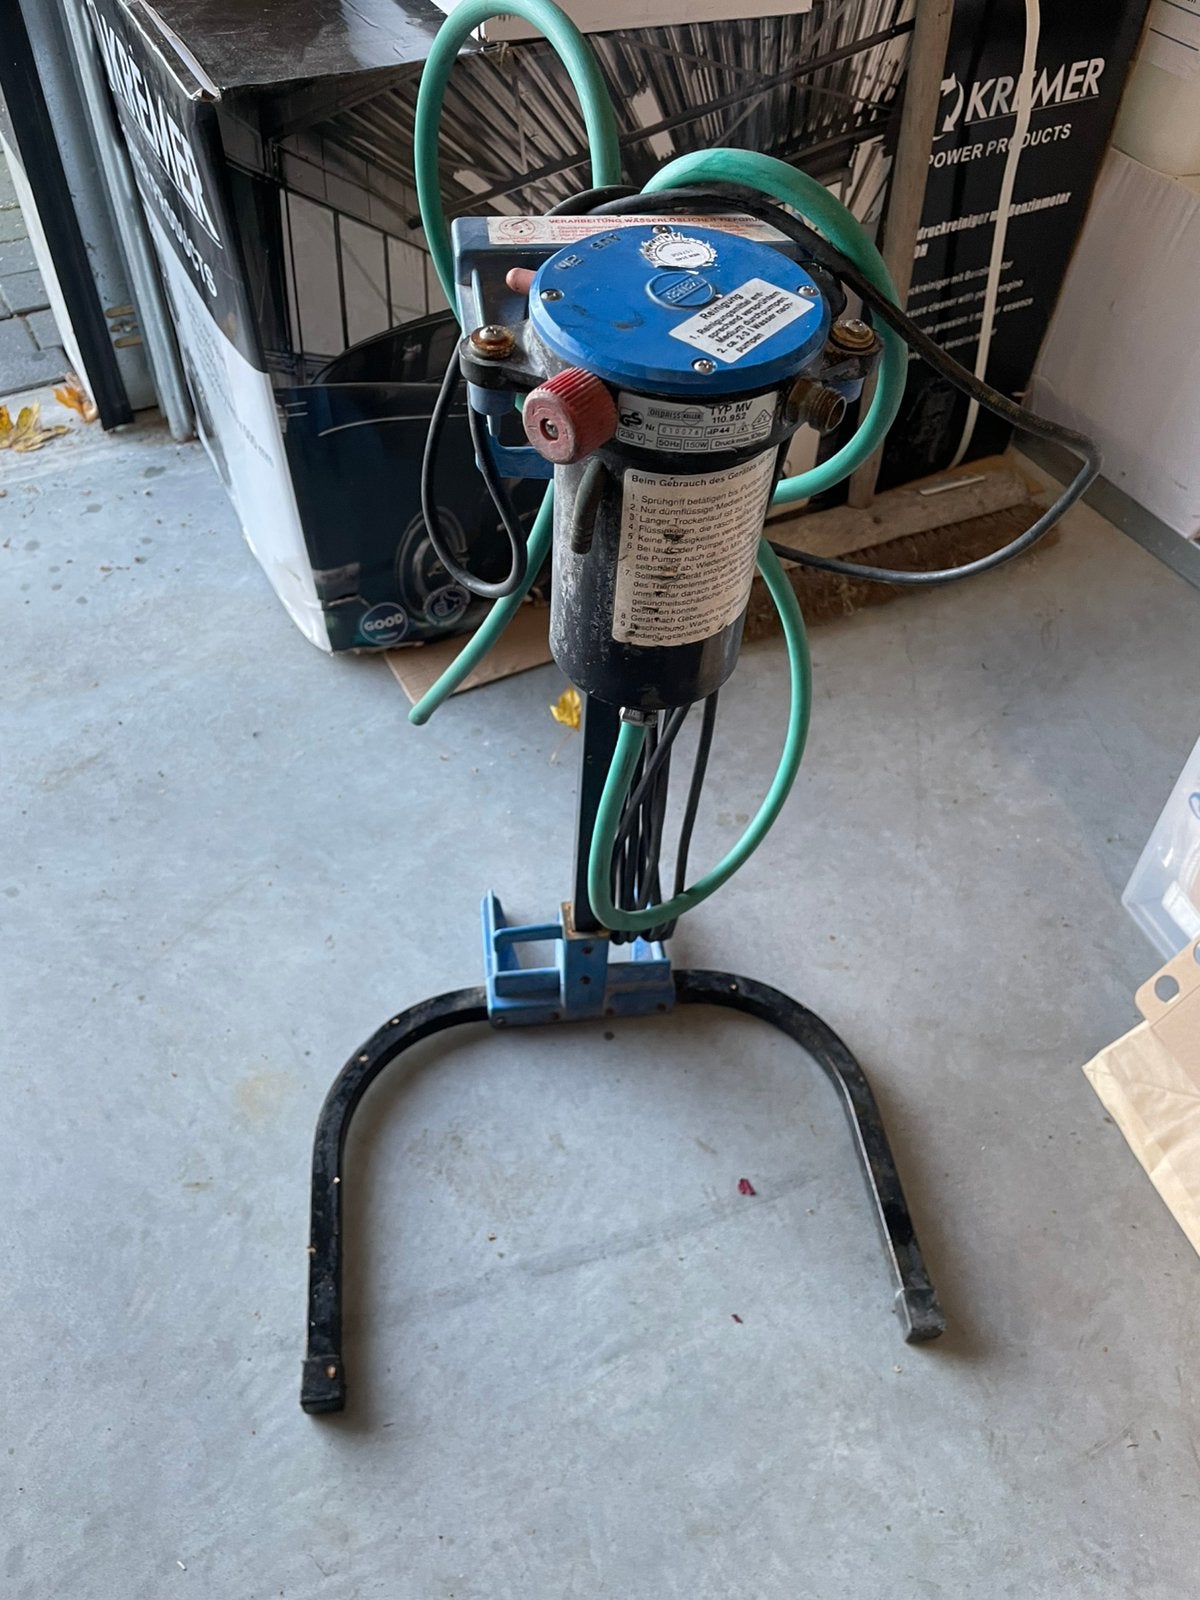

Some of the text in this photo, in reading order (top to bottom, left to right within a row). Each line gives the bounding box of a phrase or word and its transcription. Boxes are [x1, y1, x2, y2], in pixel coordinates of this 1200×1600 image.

[101, 12, 222, 243] KREMER
[699, 293, 743, 320] Reinigung
[697, 300, 751, 335] Reinigungsmittel
[708, 291, 782, 339] sprechend versprühtem
[715, 323, 745, 343] Medium
[736, 330, 750, 341] 2-3
[751, 312, 777, 330] Wasser
[736, 333, 765, 353] pumpen
[710, 401, 753, 415] TYP MV
[712, 412, 746, 424] 110.952
[645, 423, 656, 432] Nr.
[658, 440, 680, 448] 50Hz
[686, 440, 708, 448] 150W
[715, 439, 735, 448] Druck
[631, 474, 656, 486] Beim
[659, 478, 707, 488] Gebrauch
[709, 477, 726, 485] des
[687, 493, 727, 505] betätigen
[640, 505, 656, 514] Nur
[658, 506, 714, 516] dünnflüssige
[640, 515, 670, 525] Langer
[673, 513, 722, 525] Trockenlauf
[638, 534, 663, 544] Keine
[696, 540, 724, 551] Pumpe
[651, 555, 682, 563] Pumpe
[681, 587, 710, 597] danach
[364, 613, 403, 631] GOOD
[630, 614, 654, 623] Gerät
[677, 609, 714, 623] Gebrauch
[626, 626, 710, 640] edienungsanleitung
